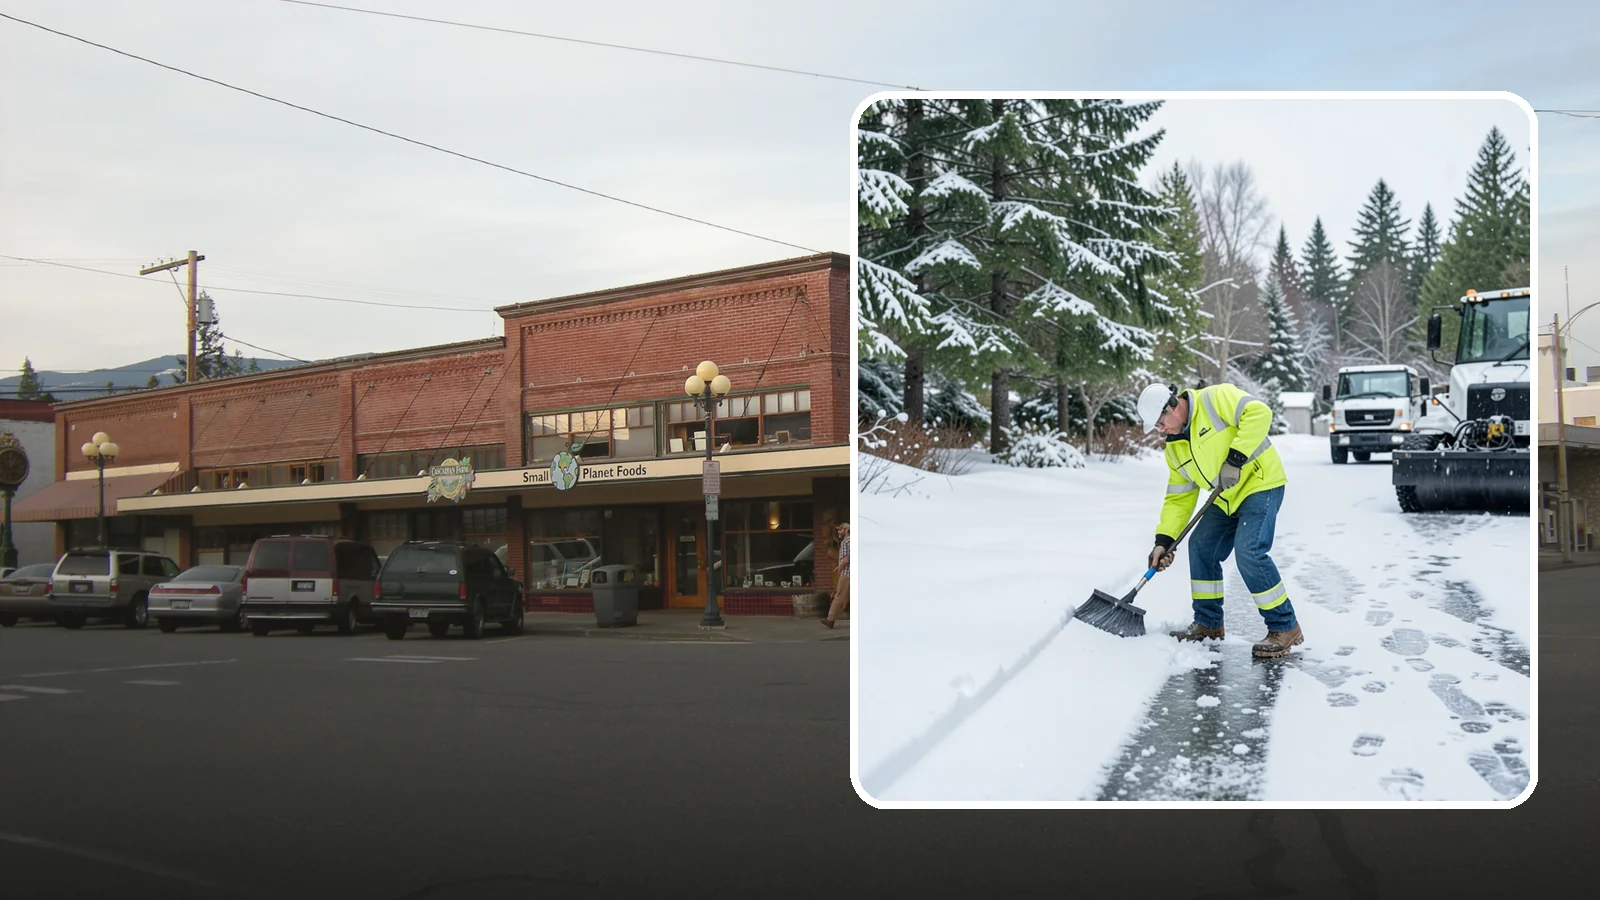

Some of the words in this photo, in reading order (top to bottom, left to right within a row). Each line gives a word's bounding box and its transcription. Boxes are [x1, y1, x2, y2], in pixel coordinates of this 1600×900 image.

[523, 471, 549, 483] Small
[583, 467, 614, 479] Planet
[617, 464, 647, 477] Foods
